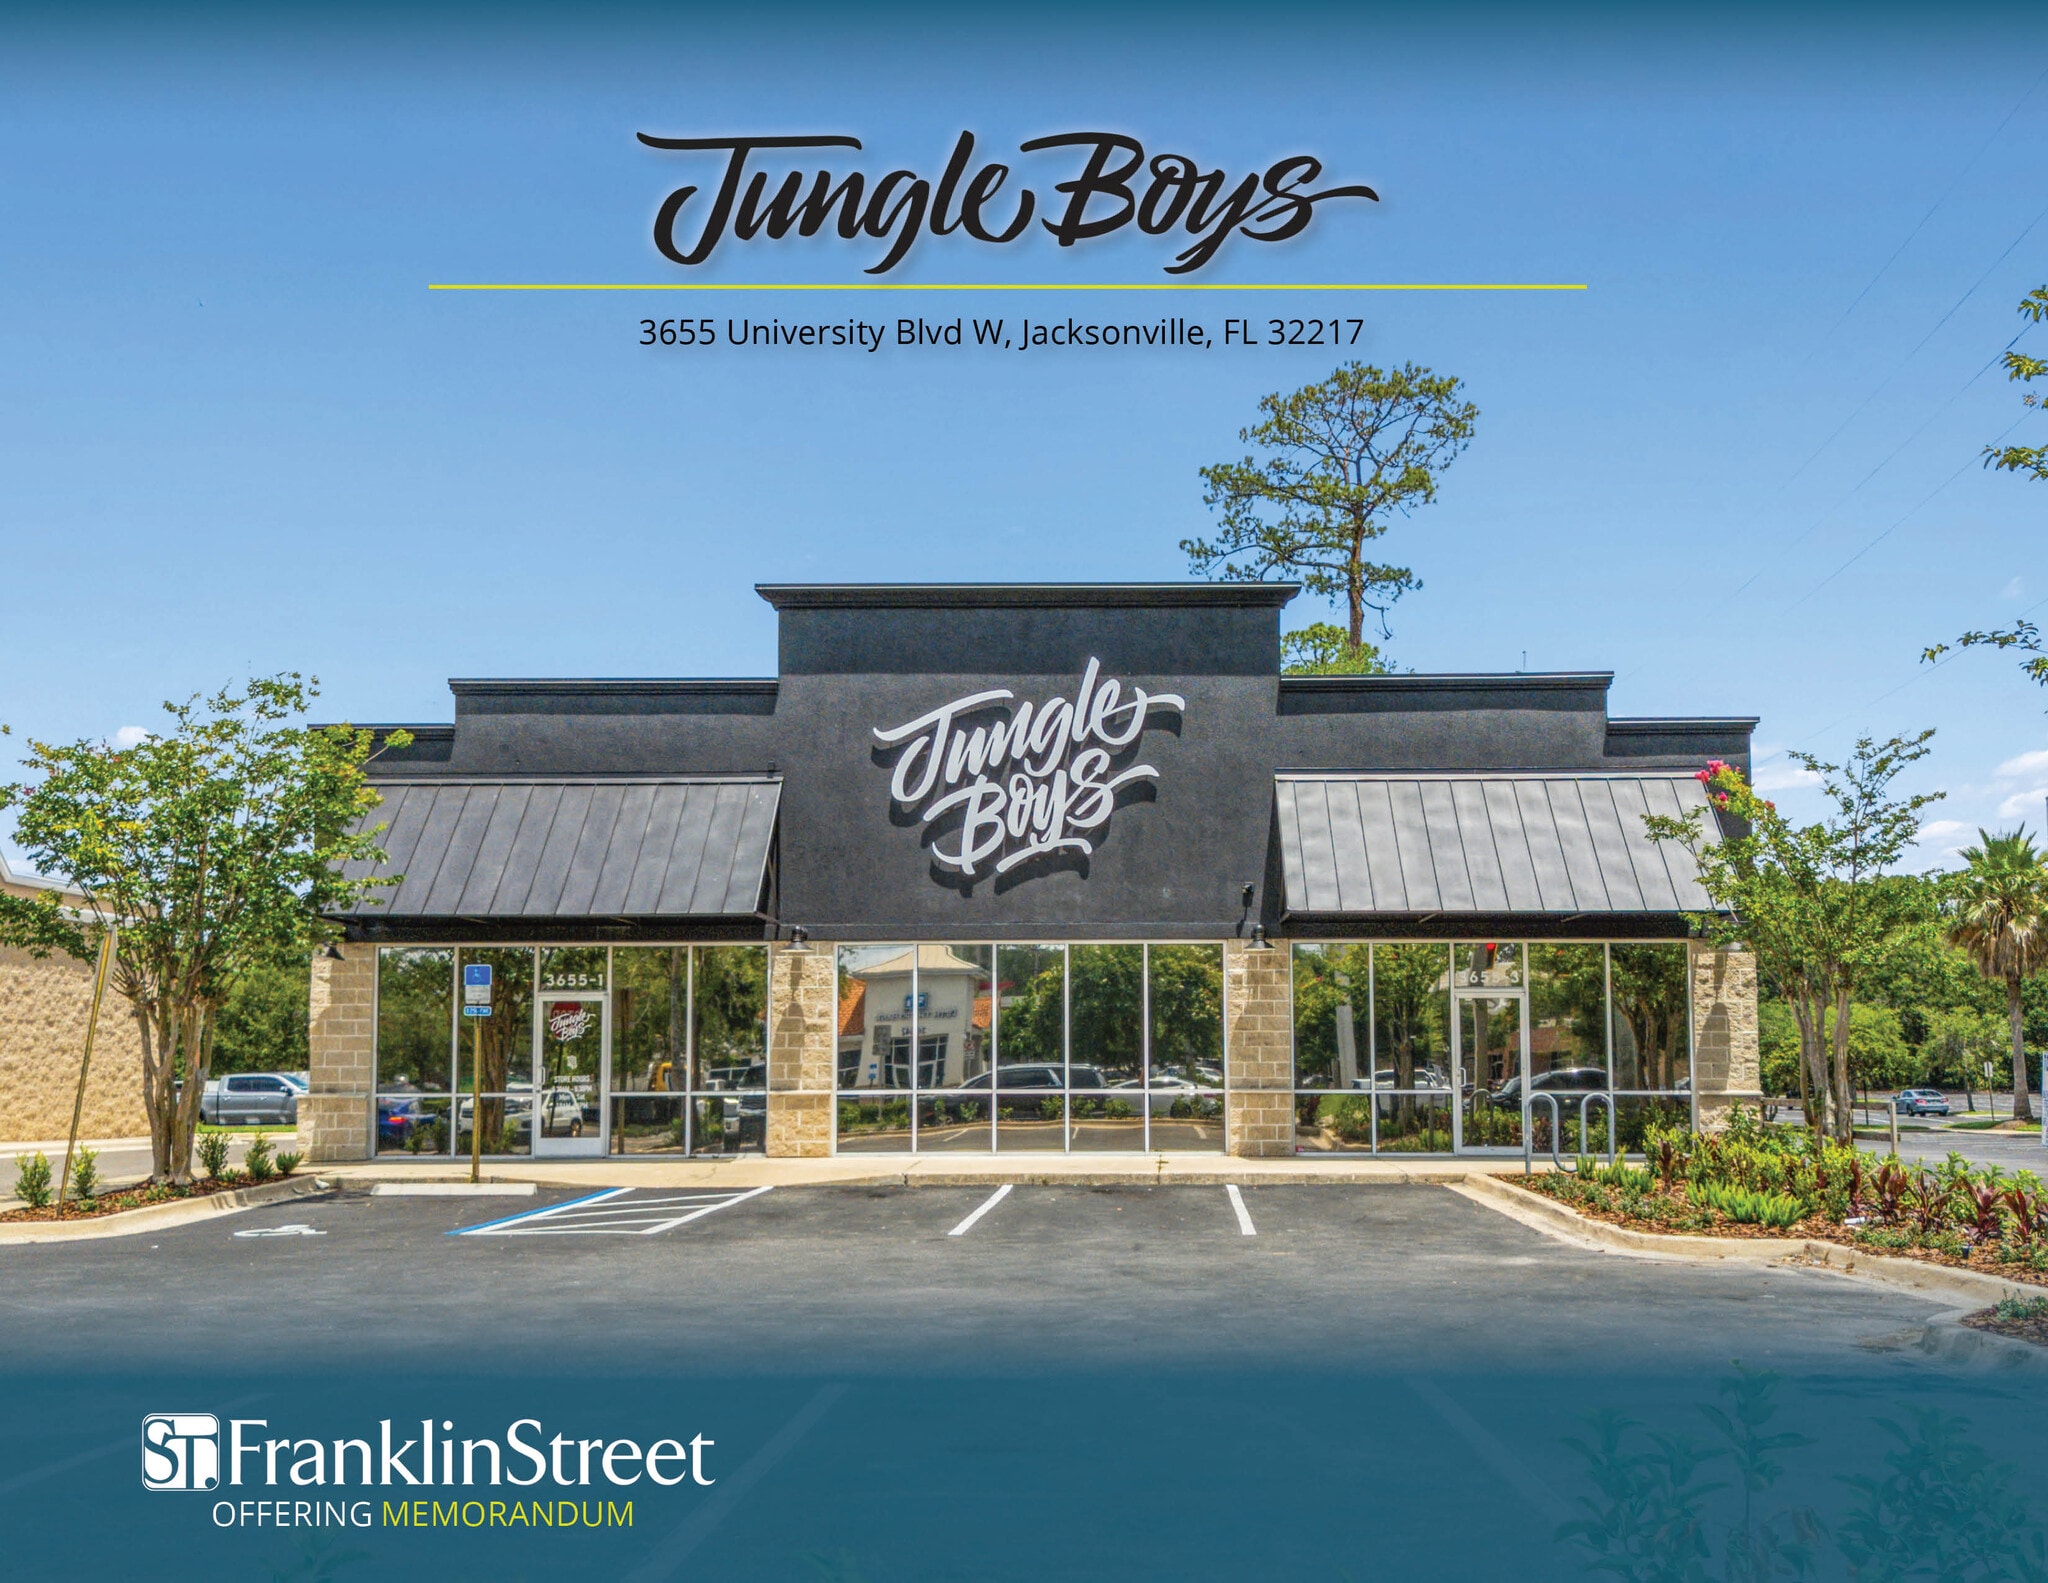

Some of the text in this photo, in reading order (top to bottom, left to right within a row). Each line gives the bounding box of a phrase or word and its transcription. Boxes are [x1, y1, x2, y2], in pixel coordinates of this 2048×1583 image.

[873, 656, 1185, 801] Jungle
[923, 748, 1160, 875] Boys
[546, 973, 604, 987] 3655-1
[549, 1008, 597, 1032] Jungle
[555, 1023, 592, 1042] Boys
